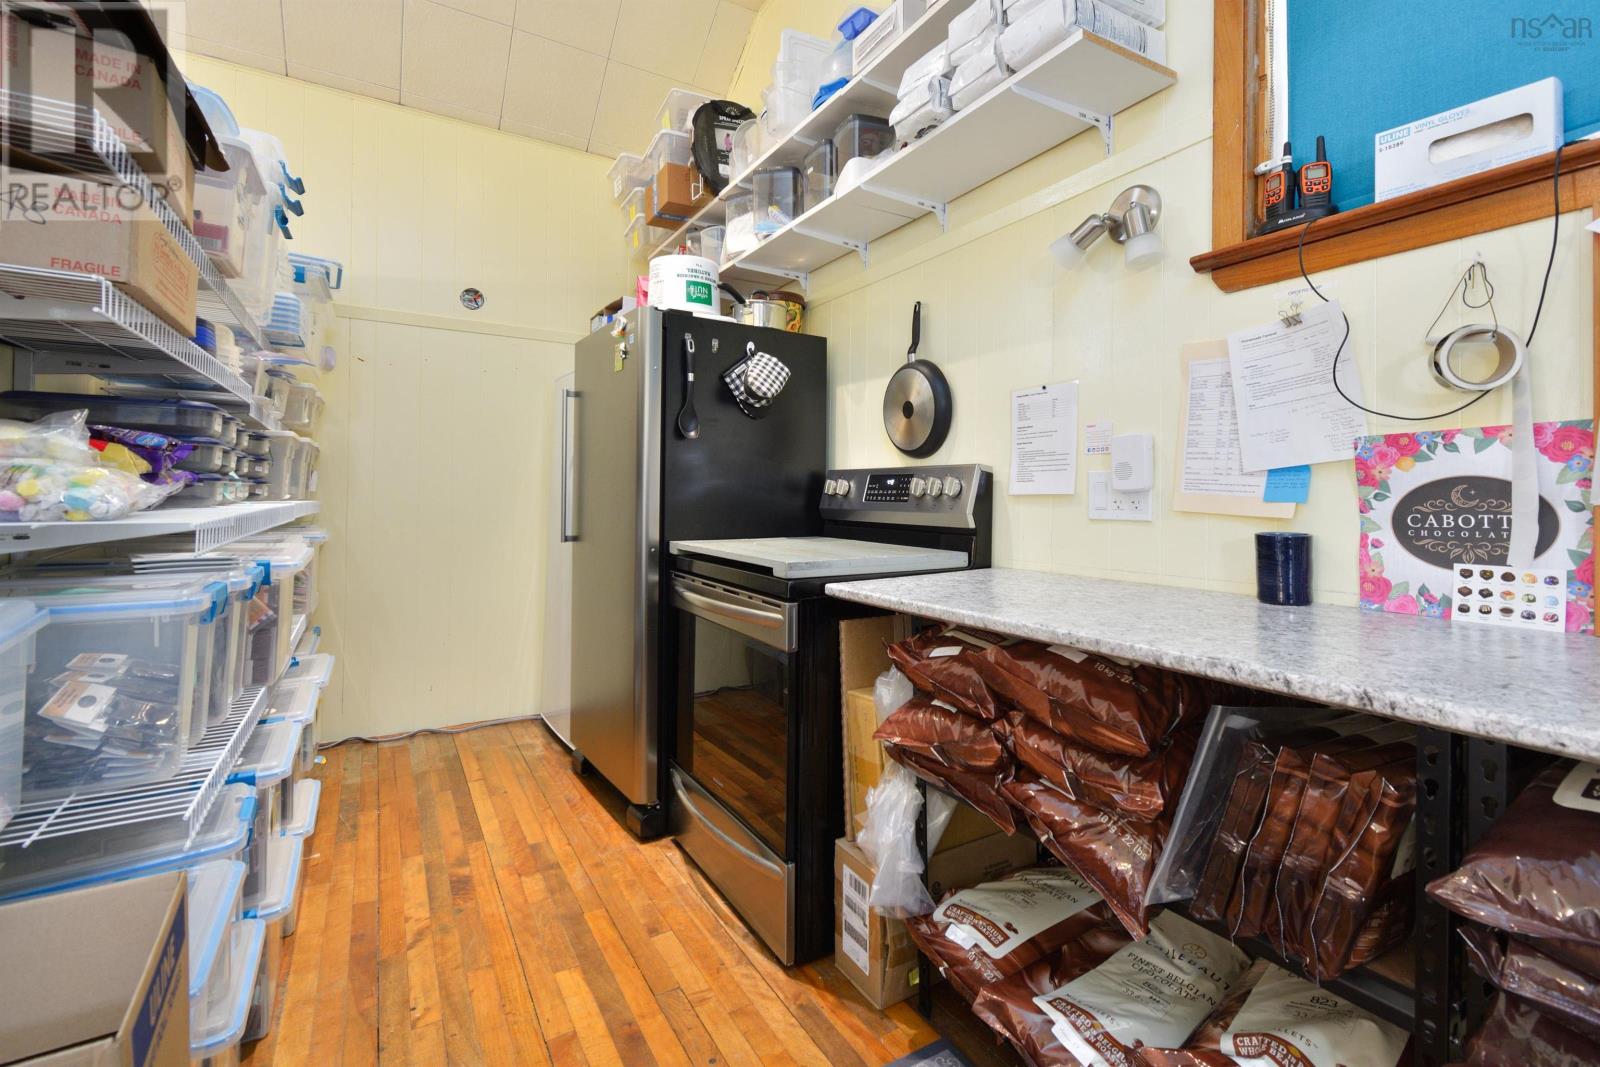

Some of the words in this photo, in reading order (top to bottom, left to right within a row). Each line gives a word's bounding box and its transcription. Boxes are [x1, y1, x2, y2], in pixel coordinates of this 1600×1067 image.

[75, 48, 121, 70] MADE
[125, 60, 142, 75] IN
[75, 64, 142, 91] CANADA
[1414, 119, 1435, 130] VINYL
[1380, 128, 1411, 145] ULINE
[53, 204, 122, 225] CANADA
[50, 257, 121, 278] FRAGILE
[1407, 513, 1513, 530] CABOTT
[1408, 529, 1509, 539] CHOCOLAT
[1098, 811, 1109, 823] 10
[1121, 834, 1135, 847] 22
[1128, 952, 1166, 975] FINEST
[1166, 971, 1217, 1007] BELGIAN
[1310, 995, 1338, 1008] 823
[1055, 999, 1092, 1028] CRAFTED
[1076, 1020, 1097, 1043] BEAN
